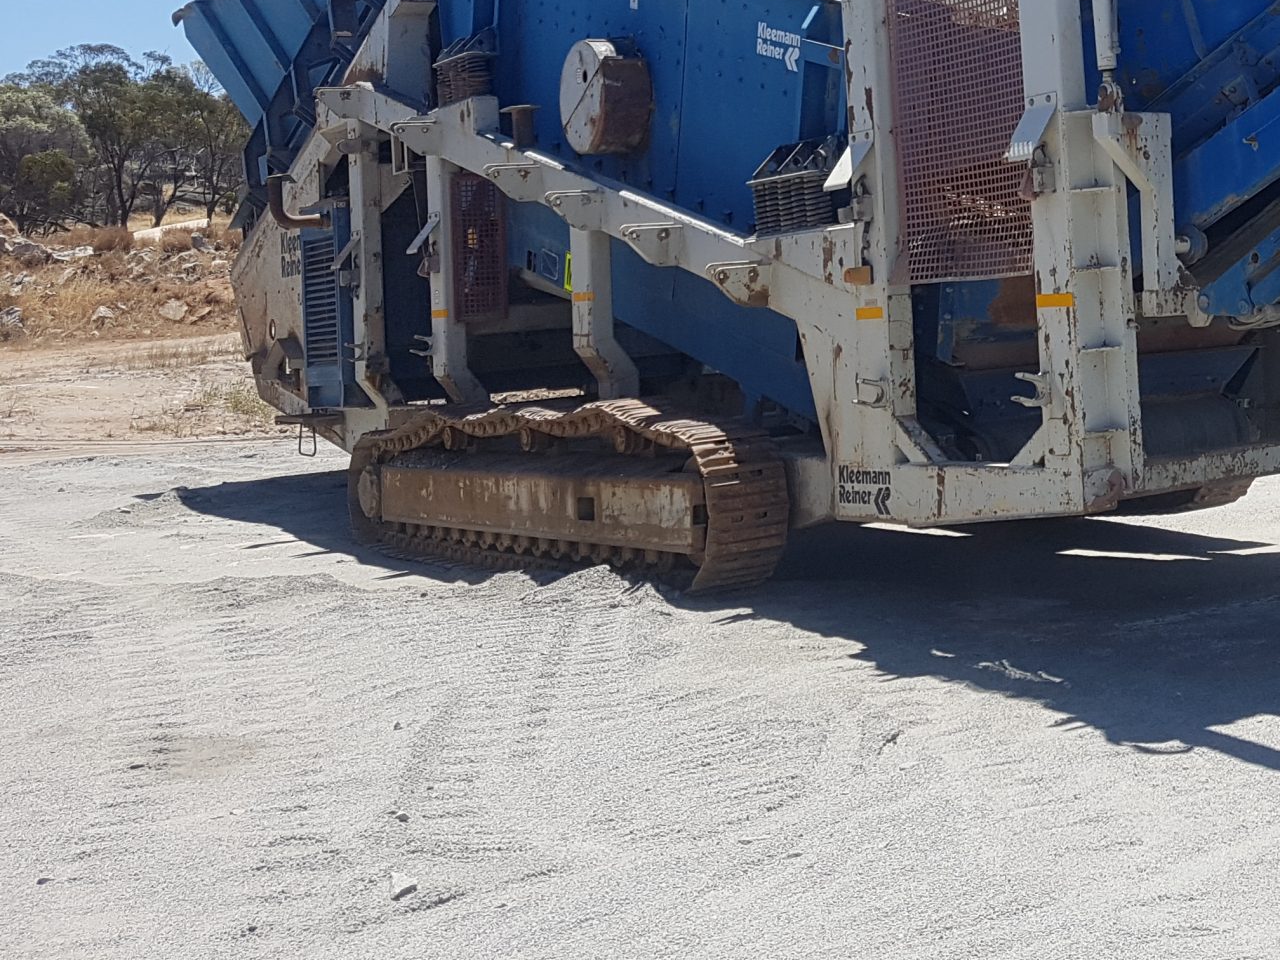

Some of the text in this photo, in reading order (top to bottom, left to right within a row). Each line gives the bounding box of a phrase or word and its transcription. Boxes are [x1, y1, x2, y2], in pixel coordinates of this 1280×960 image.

[757, 21, 801, 48] Kleemann
[756, 38, 785, 60] Reiner
[281, 256, 301, 278] Reine
[839, 465, 891, 485] Kleemann
[839, 485, 871, 504] Reiner
